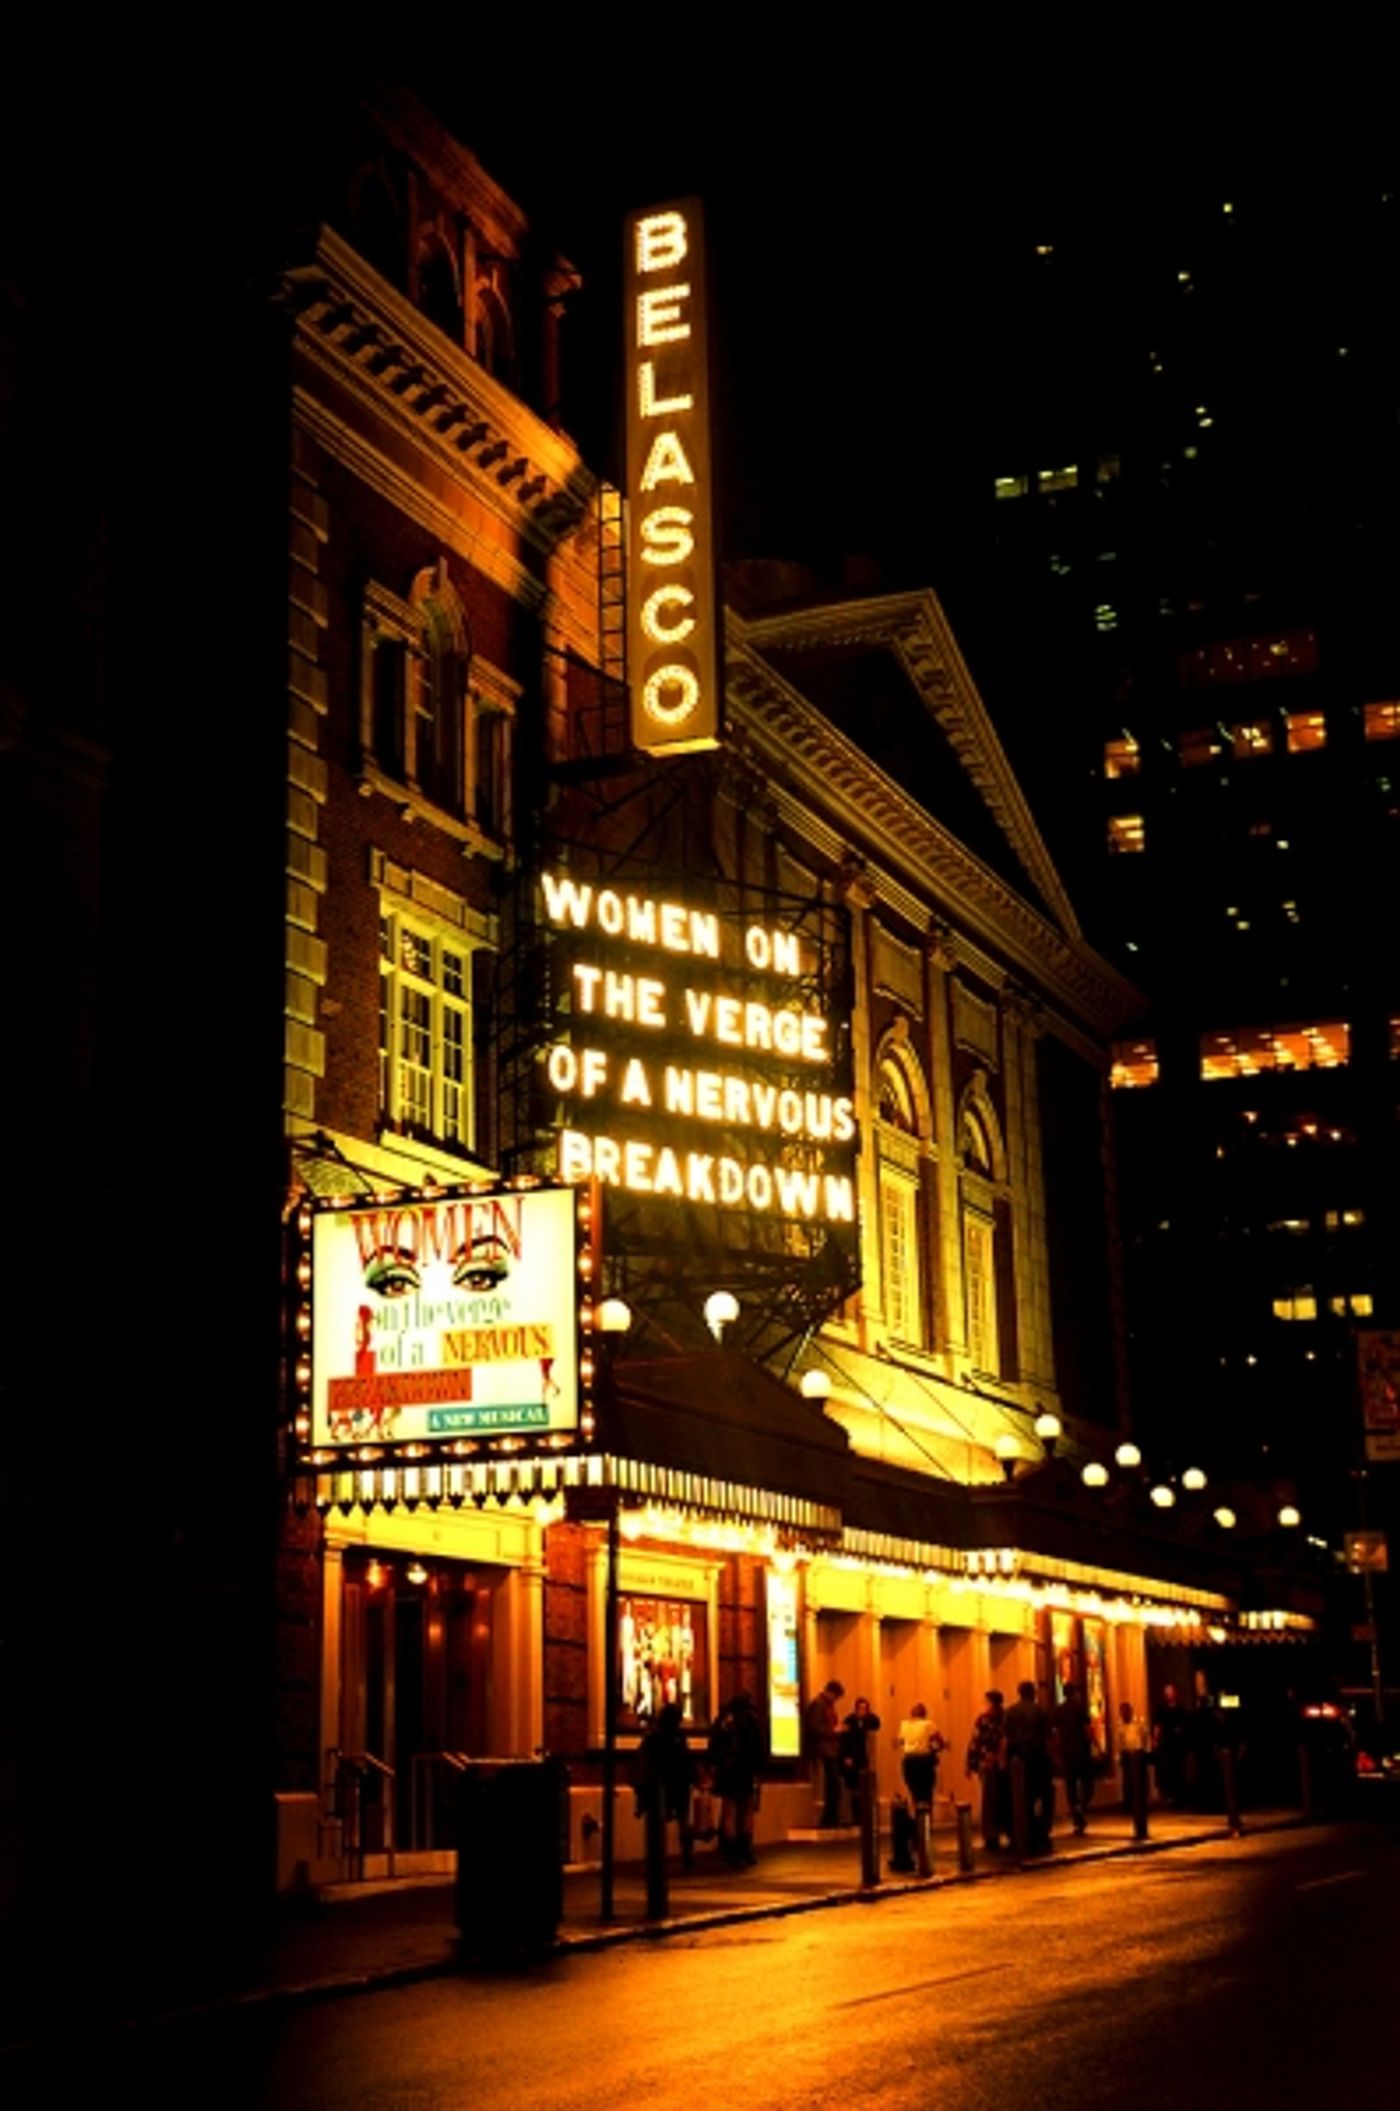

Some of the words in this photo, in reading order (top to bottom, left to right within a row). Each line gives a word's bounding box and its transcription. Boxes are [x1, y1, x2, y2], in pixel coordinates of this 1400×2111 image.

[636, 210, 701, 727] BELASCO
[541, 872, 720, 958] WOMEN
[745, 925, 801, 977] ON
[572, 963, 667, 1028] THE
[685, 988, 829, 1062] VERGE
[548, 1045, 608, 1097] OF
[621, 1058, 652, 1106] A
[665, 1065, 856, 1141] NERVOUS
[560, 1129, 855, 1222] BREAKDOWN
[350, 1197, 523, 1270] WOMEN
[380, 1331, 405, 1367] of
[411, 1342, 424, 1366] a
[443, 1326, 549, 1363] NERVOUS
[478, 1406, 547, 1425] MUSICAL
